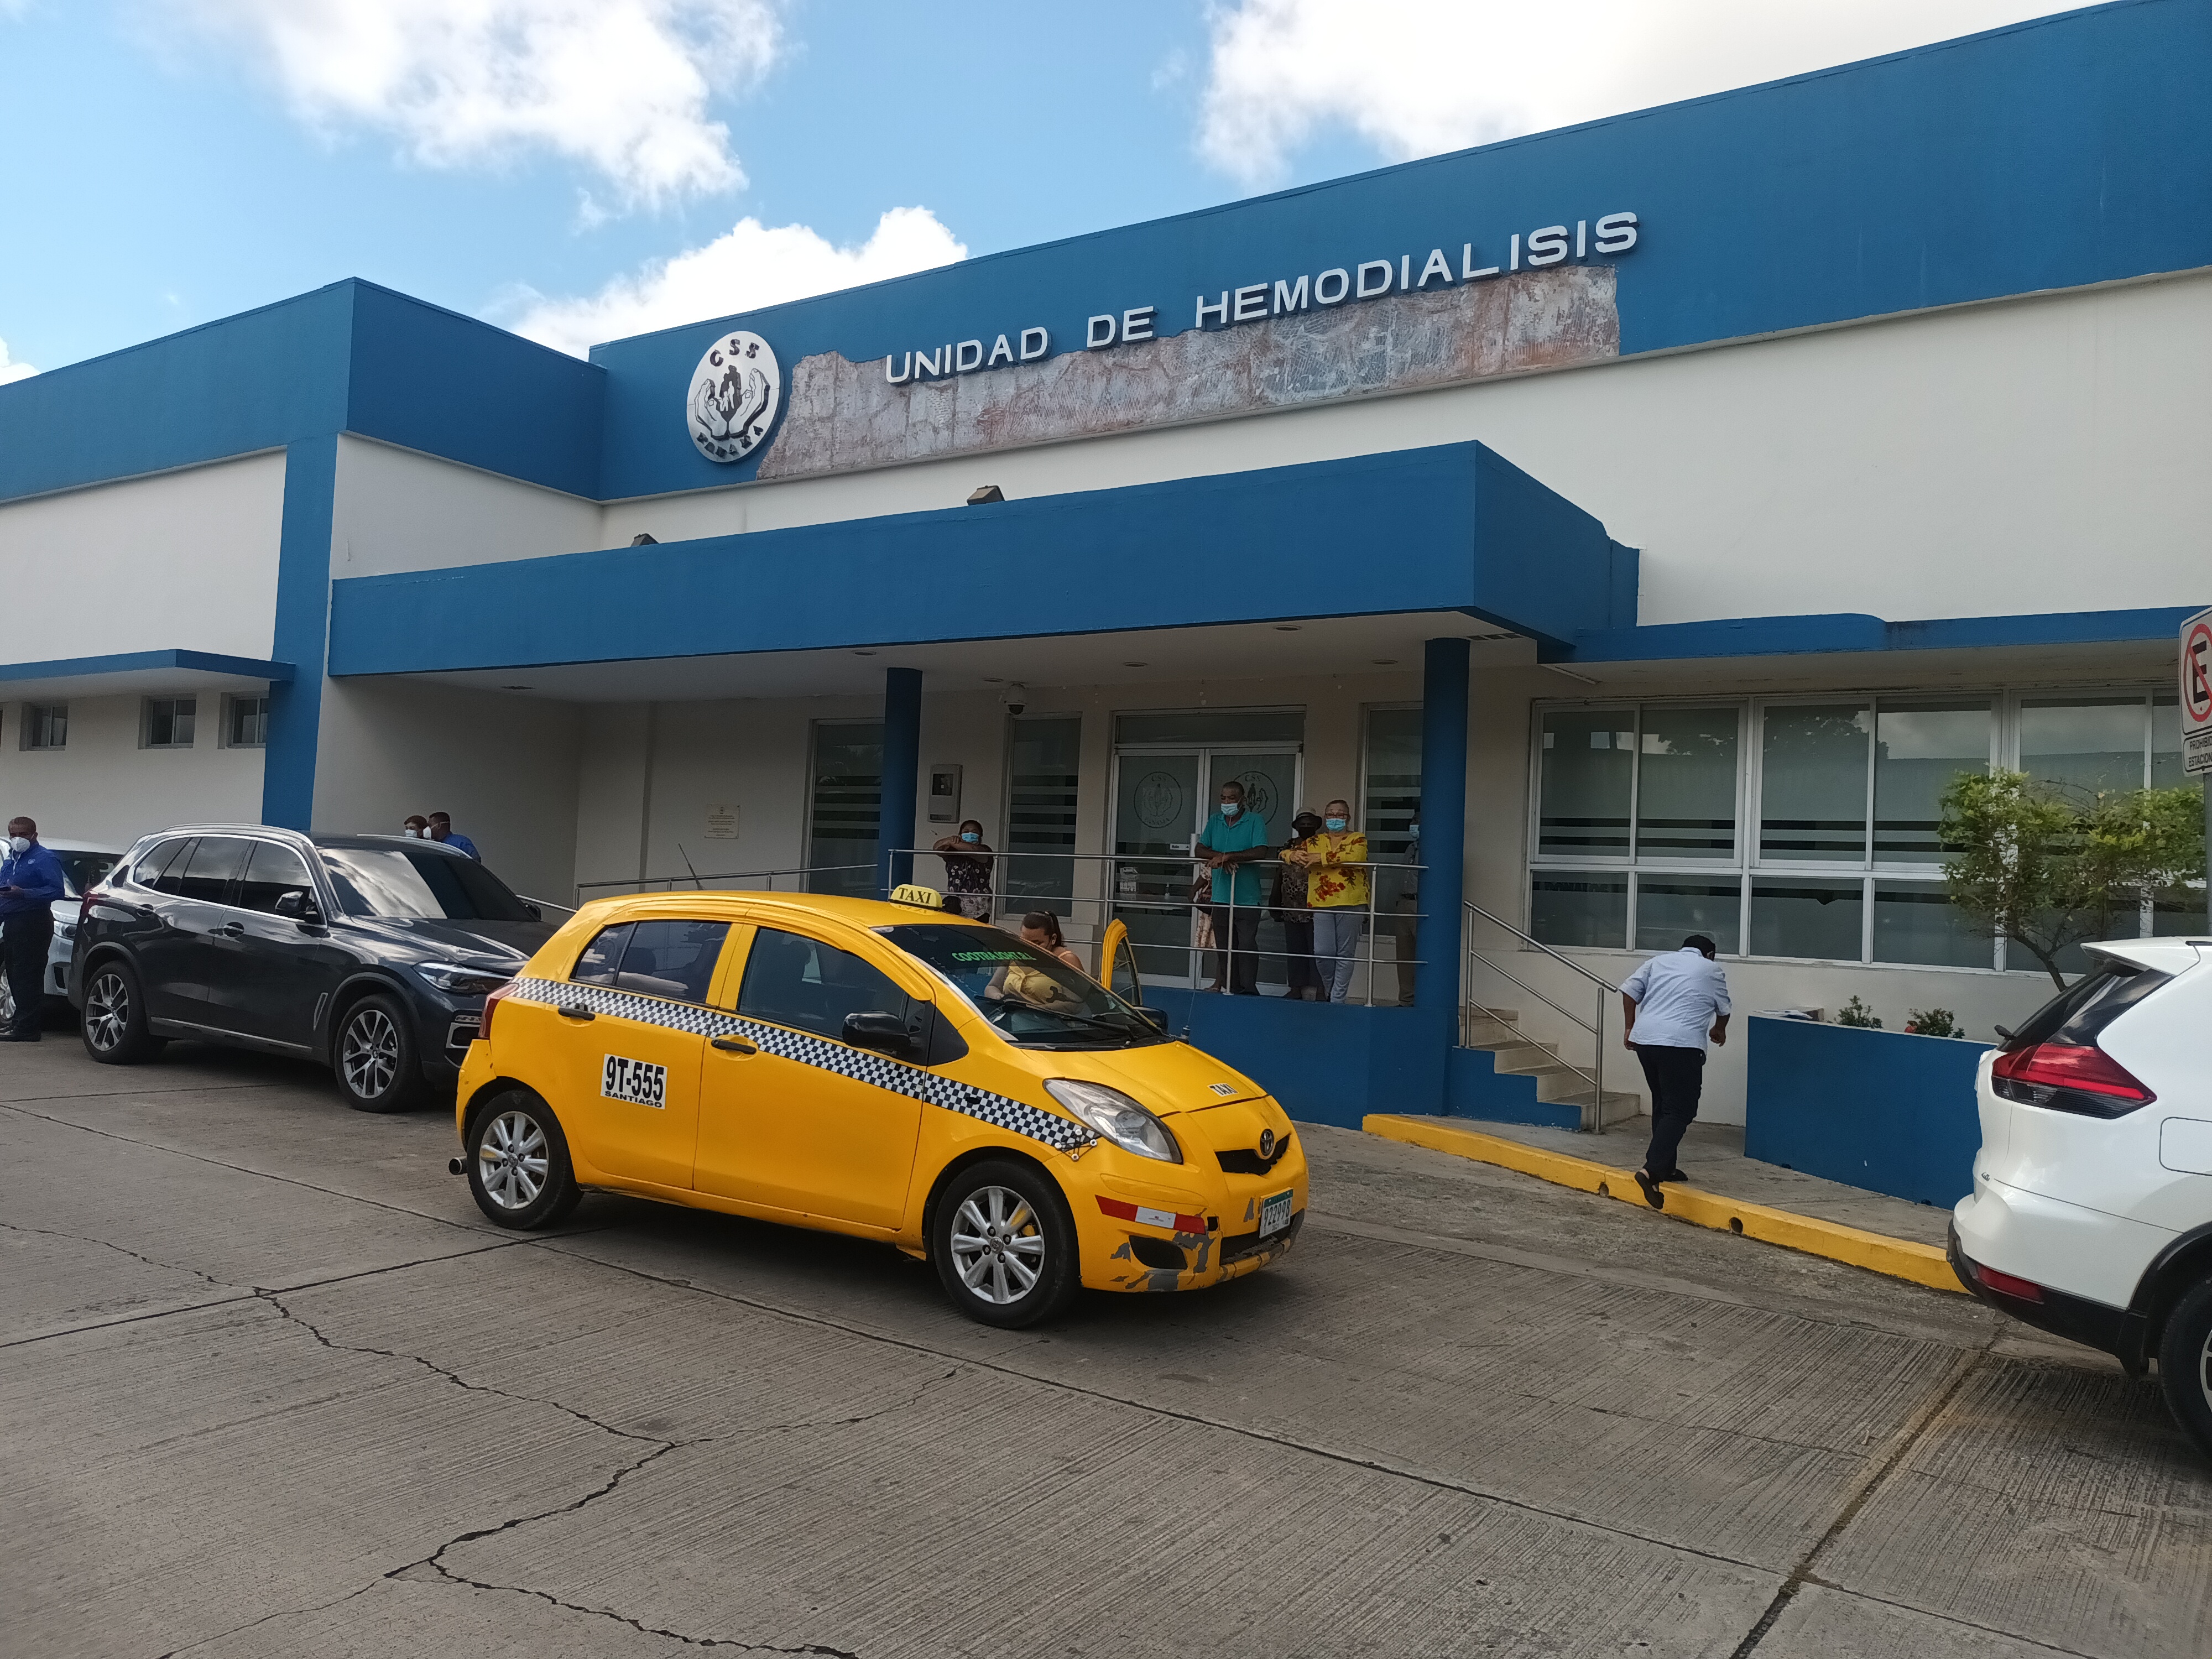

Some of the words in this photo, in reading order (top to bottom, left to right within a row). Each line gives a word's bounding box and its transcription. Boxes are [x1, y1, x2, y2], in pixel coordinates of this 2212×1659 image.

[885, 325, 1050, 384] UNIDAD
[1087, 305, 1155, 348] DE
[1196, 211, 1639, 329] HEMODIALISIS
[710, 338, 760, 367] CSS
[899, 887, 932, 904] TAXI
[606, 1056, 664, 1101] 9T-555
[1209, 1083, 1238, 1095] TAXI
[604, 1091, 662, 1108] SANTIAGO
